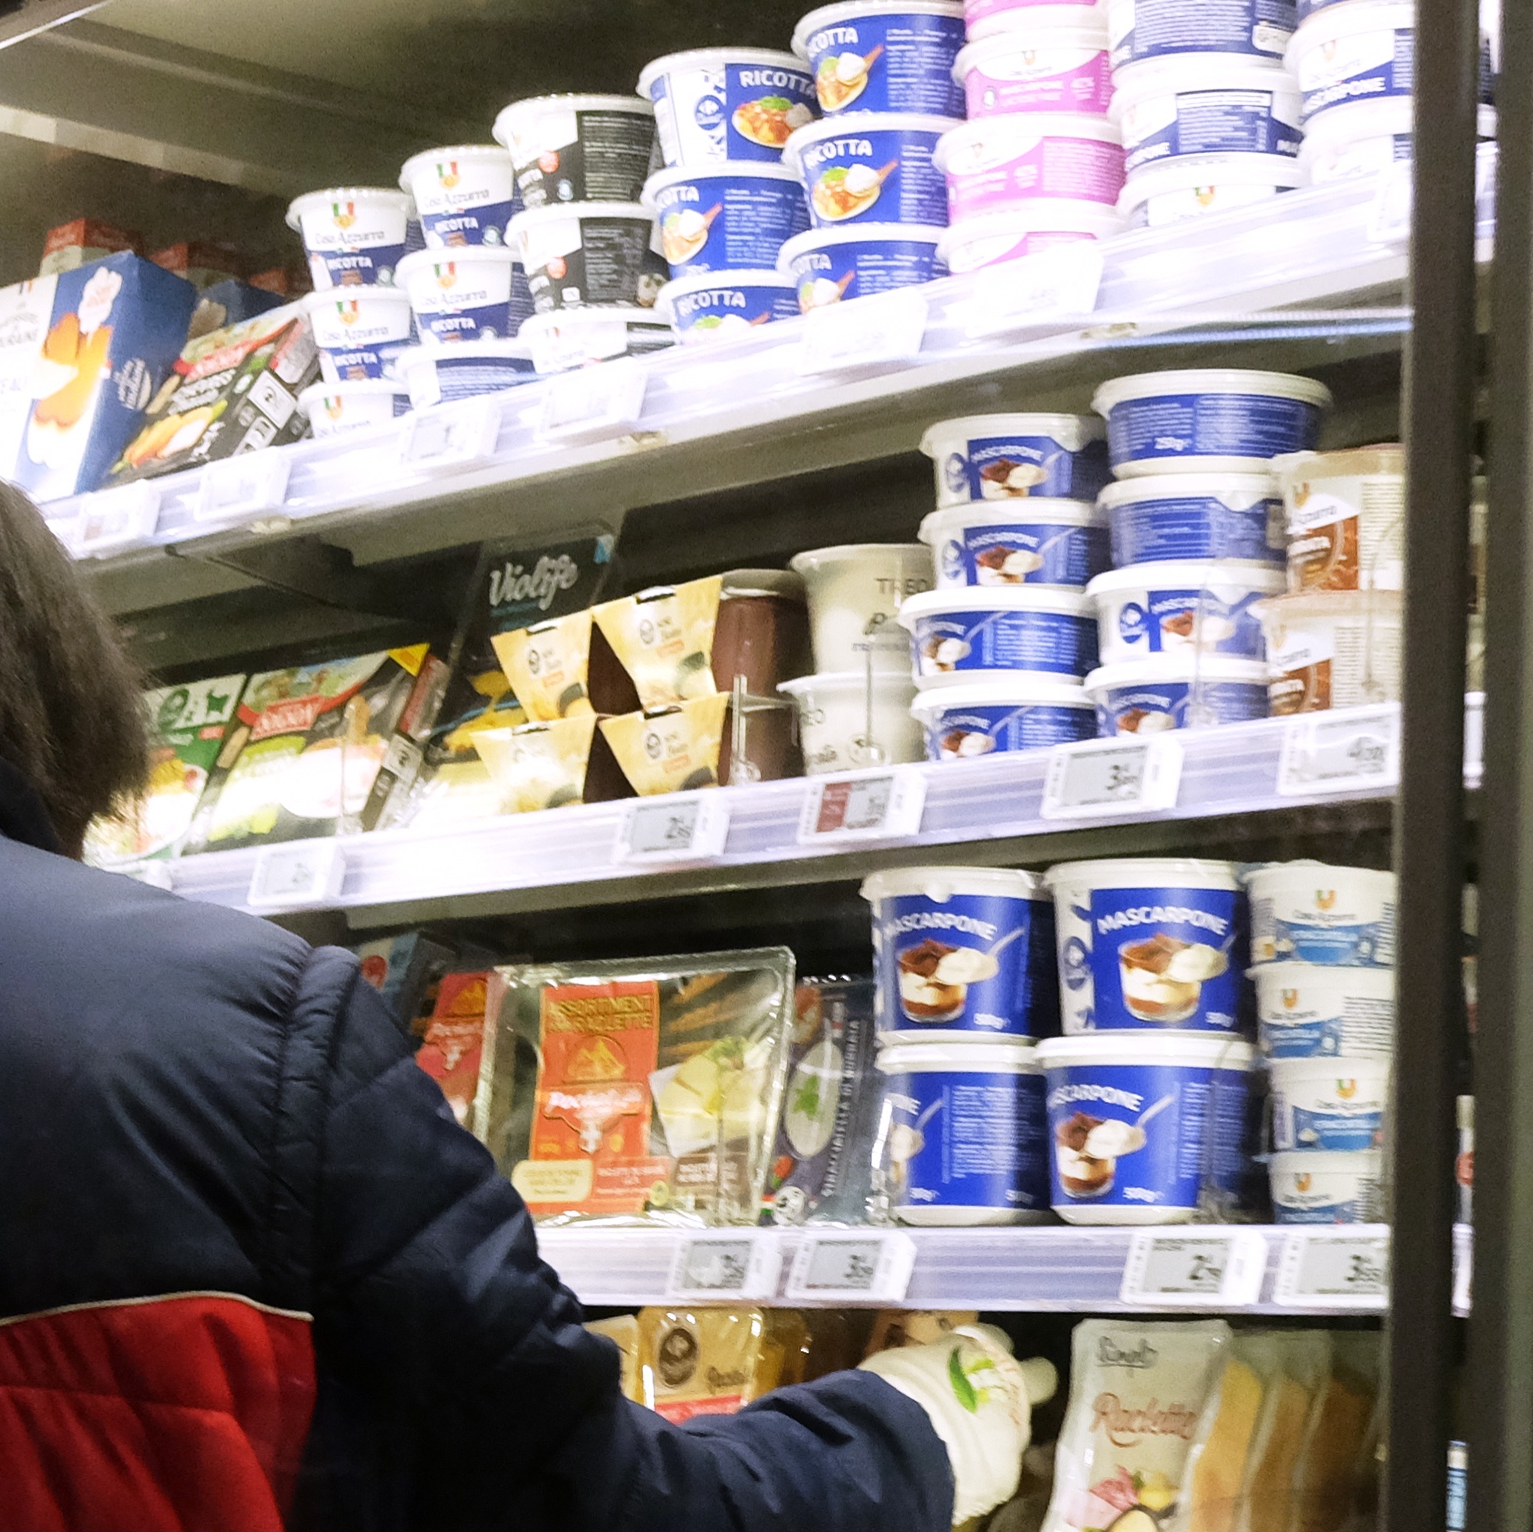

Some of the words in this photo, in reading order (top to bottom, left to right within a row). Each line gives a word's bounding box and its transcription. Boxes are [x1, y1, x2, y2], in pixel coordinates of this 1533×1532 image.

[739, 70, 817, 98] RICOTTA
[489, 554, 578, 611] Violife
[1097, 906, 1230, 935] MASCARPONE
